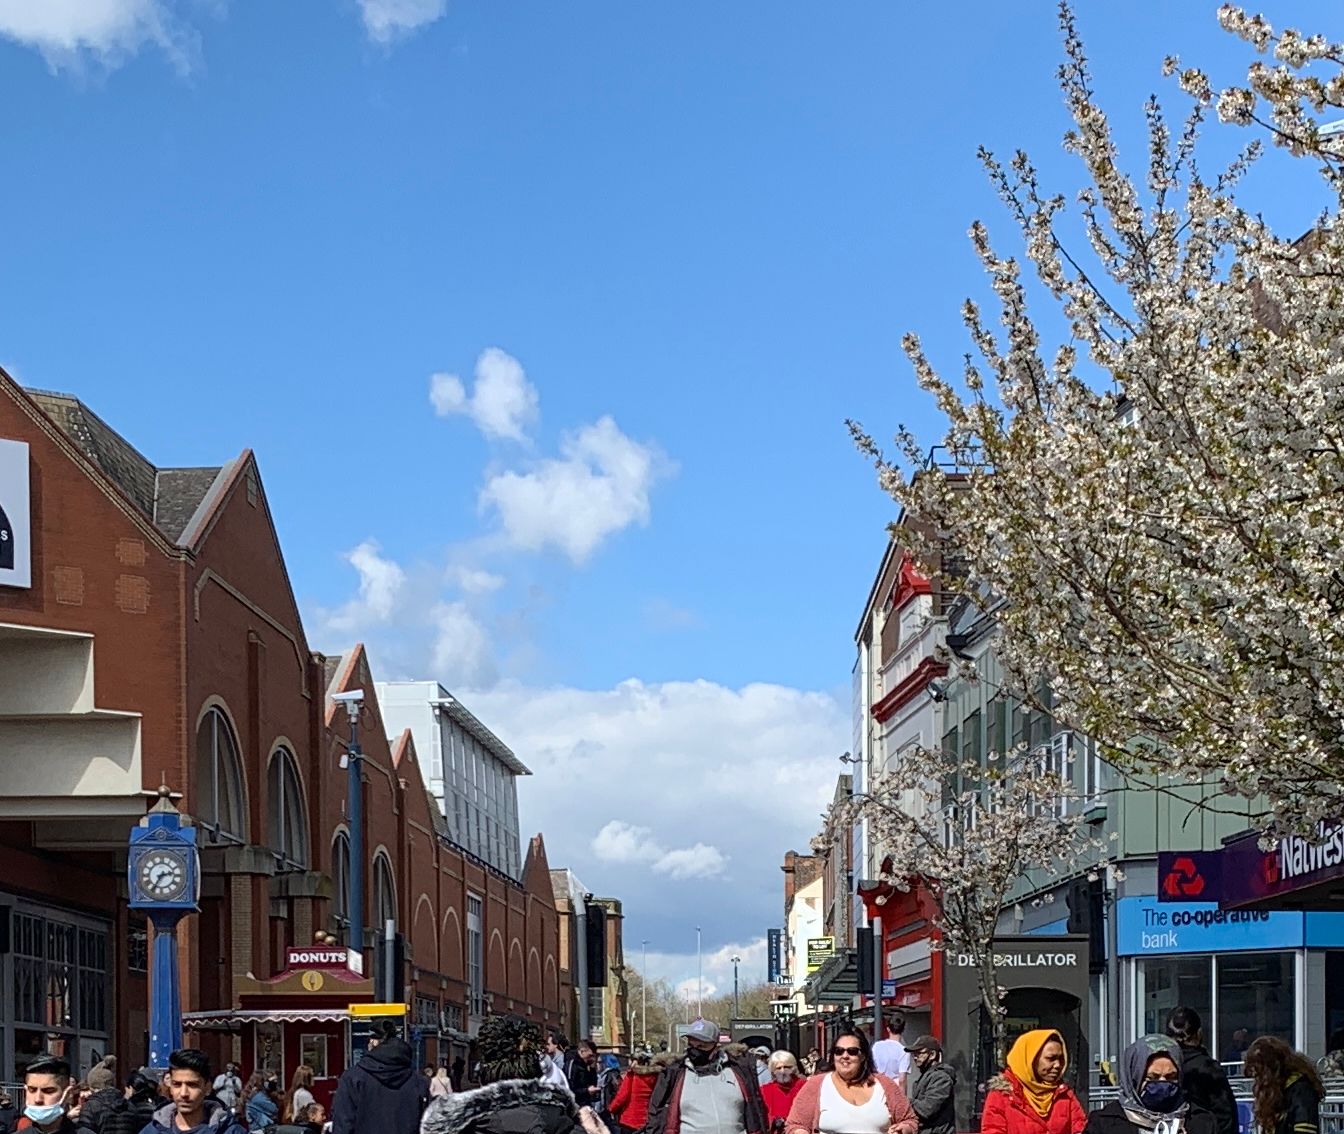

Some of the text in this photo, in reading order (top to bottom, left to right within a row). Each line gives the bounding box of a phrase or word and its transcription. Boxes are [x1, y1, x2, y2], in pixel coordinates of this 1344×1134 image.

[1142, 908, 1168, 926] The
[1142, 929, 1178, 949] bank
[289, 952, 347, 963] DONUTS
